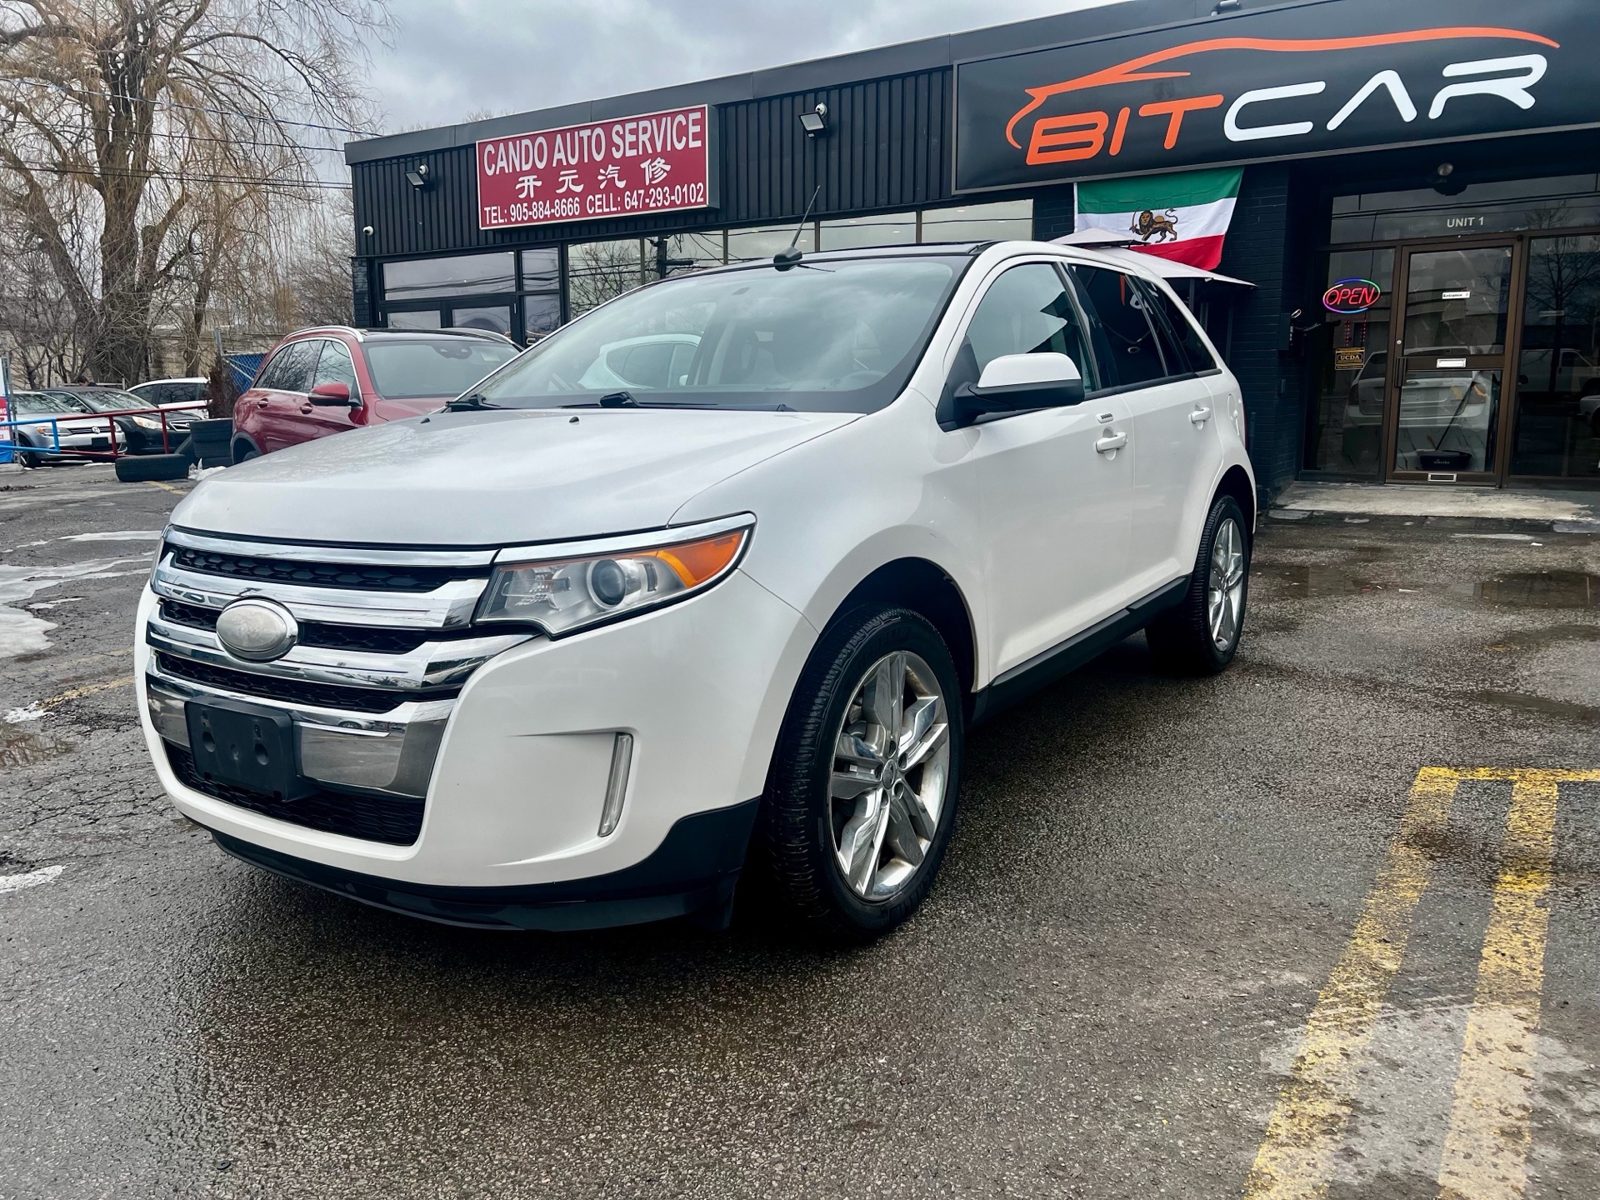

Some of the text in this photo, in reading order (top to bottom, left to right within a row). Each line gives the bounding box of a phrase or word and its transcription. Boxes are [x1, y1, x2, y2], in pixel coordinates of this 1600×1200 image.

[484, 112, 702, 176] CANDO AUTO SERVICE
[515, 156, 672, 199] 开元汽修
[484, 182, 704, 225] TEL: 905-884-8666 CELL: 647-293-0102
[1446, 216, 1485, 228] UNIT 1
[1326, 287, 1375, 305] OPEN
